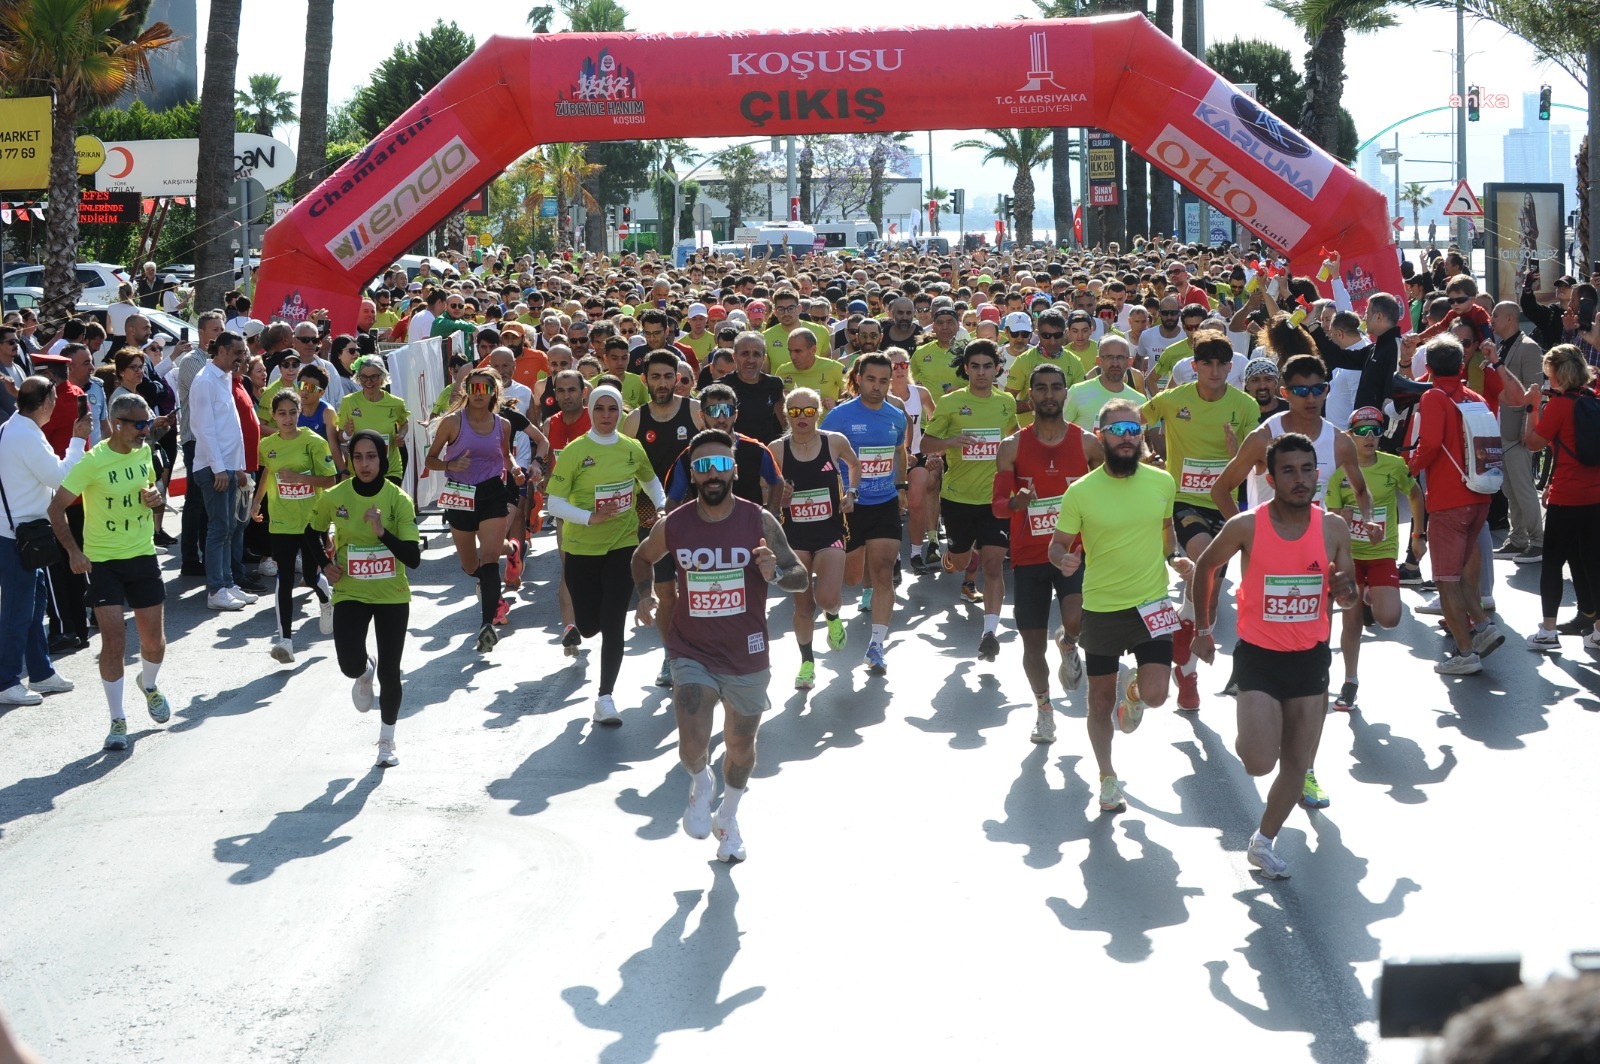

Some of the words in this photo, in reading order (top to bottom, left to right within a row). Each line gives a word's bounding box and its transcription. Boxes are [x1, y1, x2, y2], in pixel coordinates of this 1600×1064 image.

[728, 49, 904, 79] KOŞUSU
[995, 96, 1016, 104] T.C.
[1020, 93, 1087, 104] KARŞIYAKA
[555, 100, 605, 116] ZÜBEYDE
[607, 100, 644, 115] HANIM
[740, 87, 885, 127] ÇIKIŞ
[1010, 104, 1072, 114] BELEDİYESİ
[613, 115, 645, 125] KOŞUSU
[5, 148, 18, 159] 77
[21, 147, 35, 158] 69
[1195, 102, 1314, 200] KARLUNA
[1103, 161, 1114, 171] 80
[369, 143, 466, 234] endo
[83, 191, 109, 200] EFES
[1250, 218, 1289, 248] teknik
[966, 443, 997, 455] 36411
[862, 461, 890, 472] 36472
[108, 463, 147, 484] RUN
[1184, 475, 1216, 487] 3564
[280, 484, 310, 495] 35647
[442, 494, 470, 506] 36231
[794, 504, 827, 516] 36170
[676, 547, 750, 570] BOLD
[352, 559, 391, 574] 36102
[692, 591, 741, 609] 35220
[1266, 597, 1318, 614] 35409
